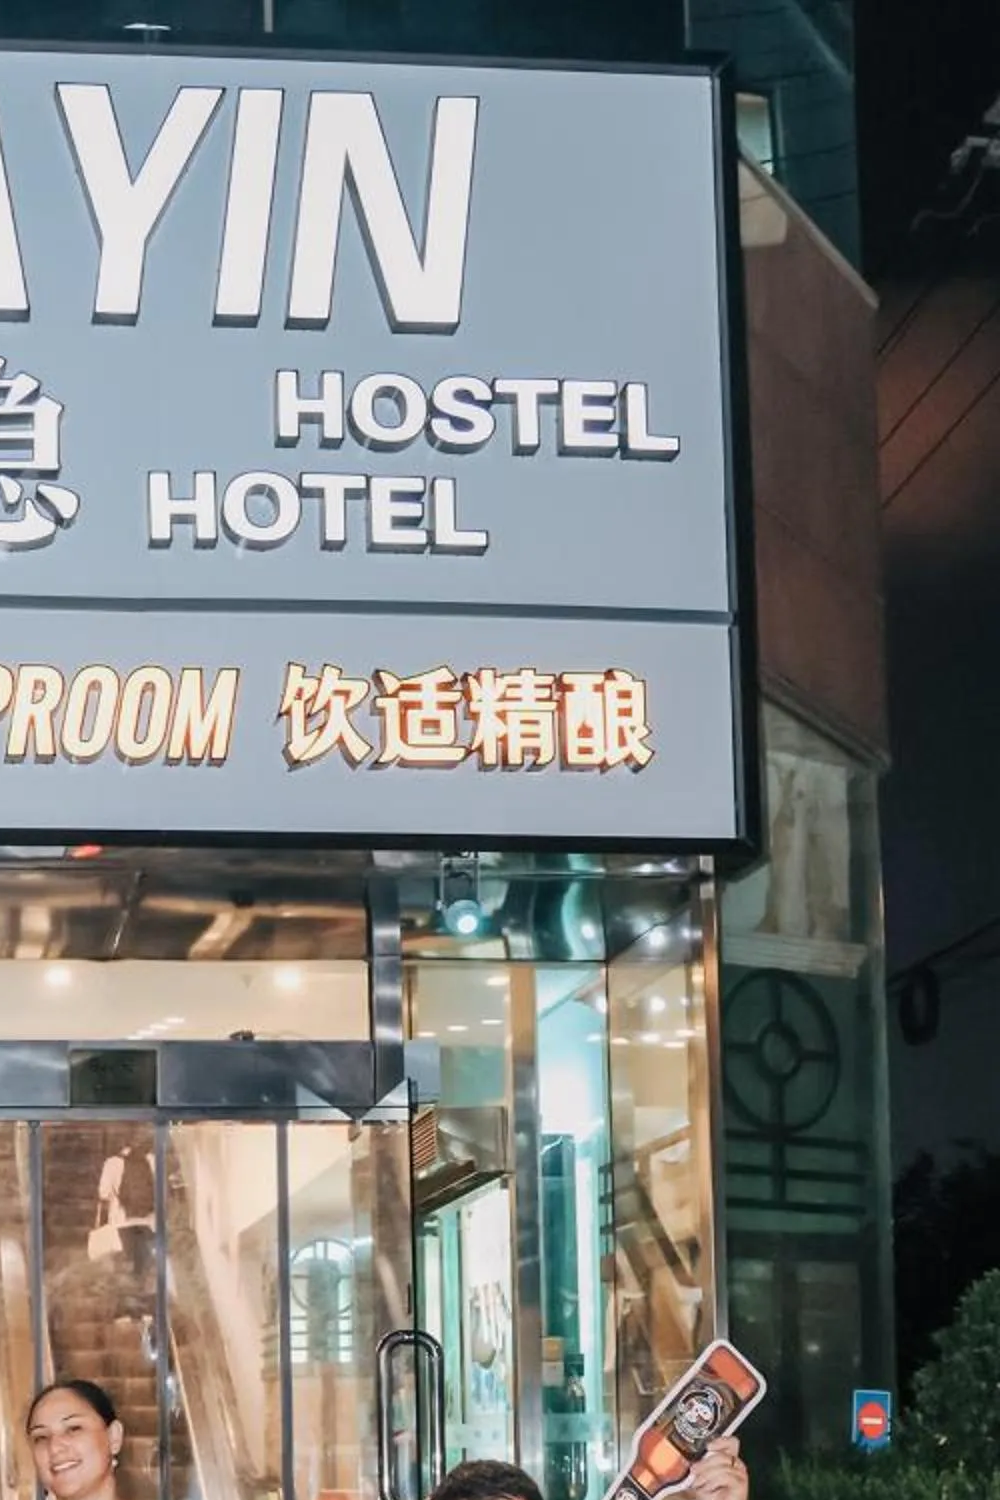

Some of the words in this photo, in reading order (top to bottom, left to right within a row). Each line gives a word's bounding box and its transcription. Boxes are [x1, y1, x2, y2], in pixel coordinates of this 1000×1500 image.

[274, 369, 681, 461] HOSTEL
[148, 471, 489, 556] HOTEL
[278, 662, 656, 774] 饮适精酿
